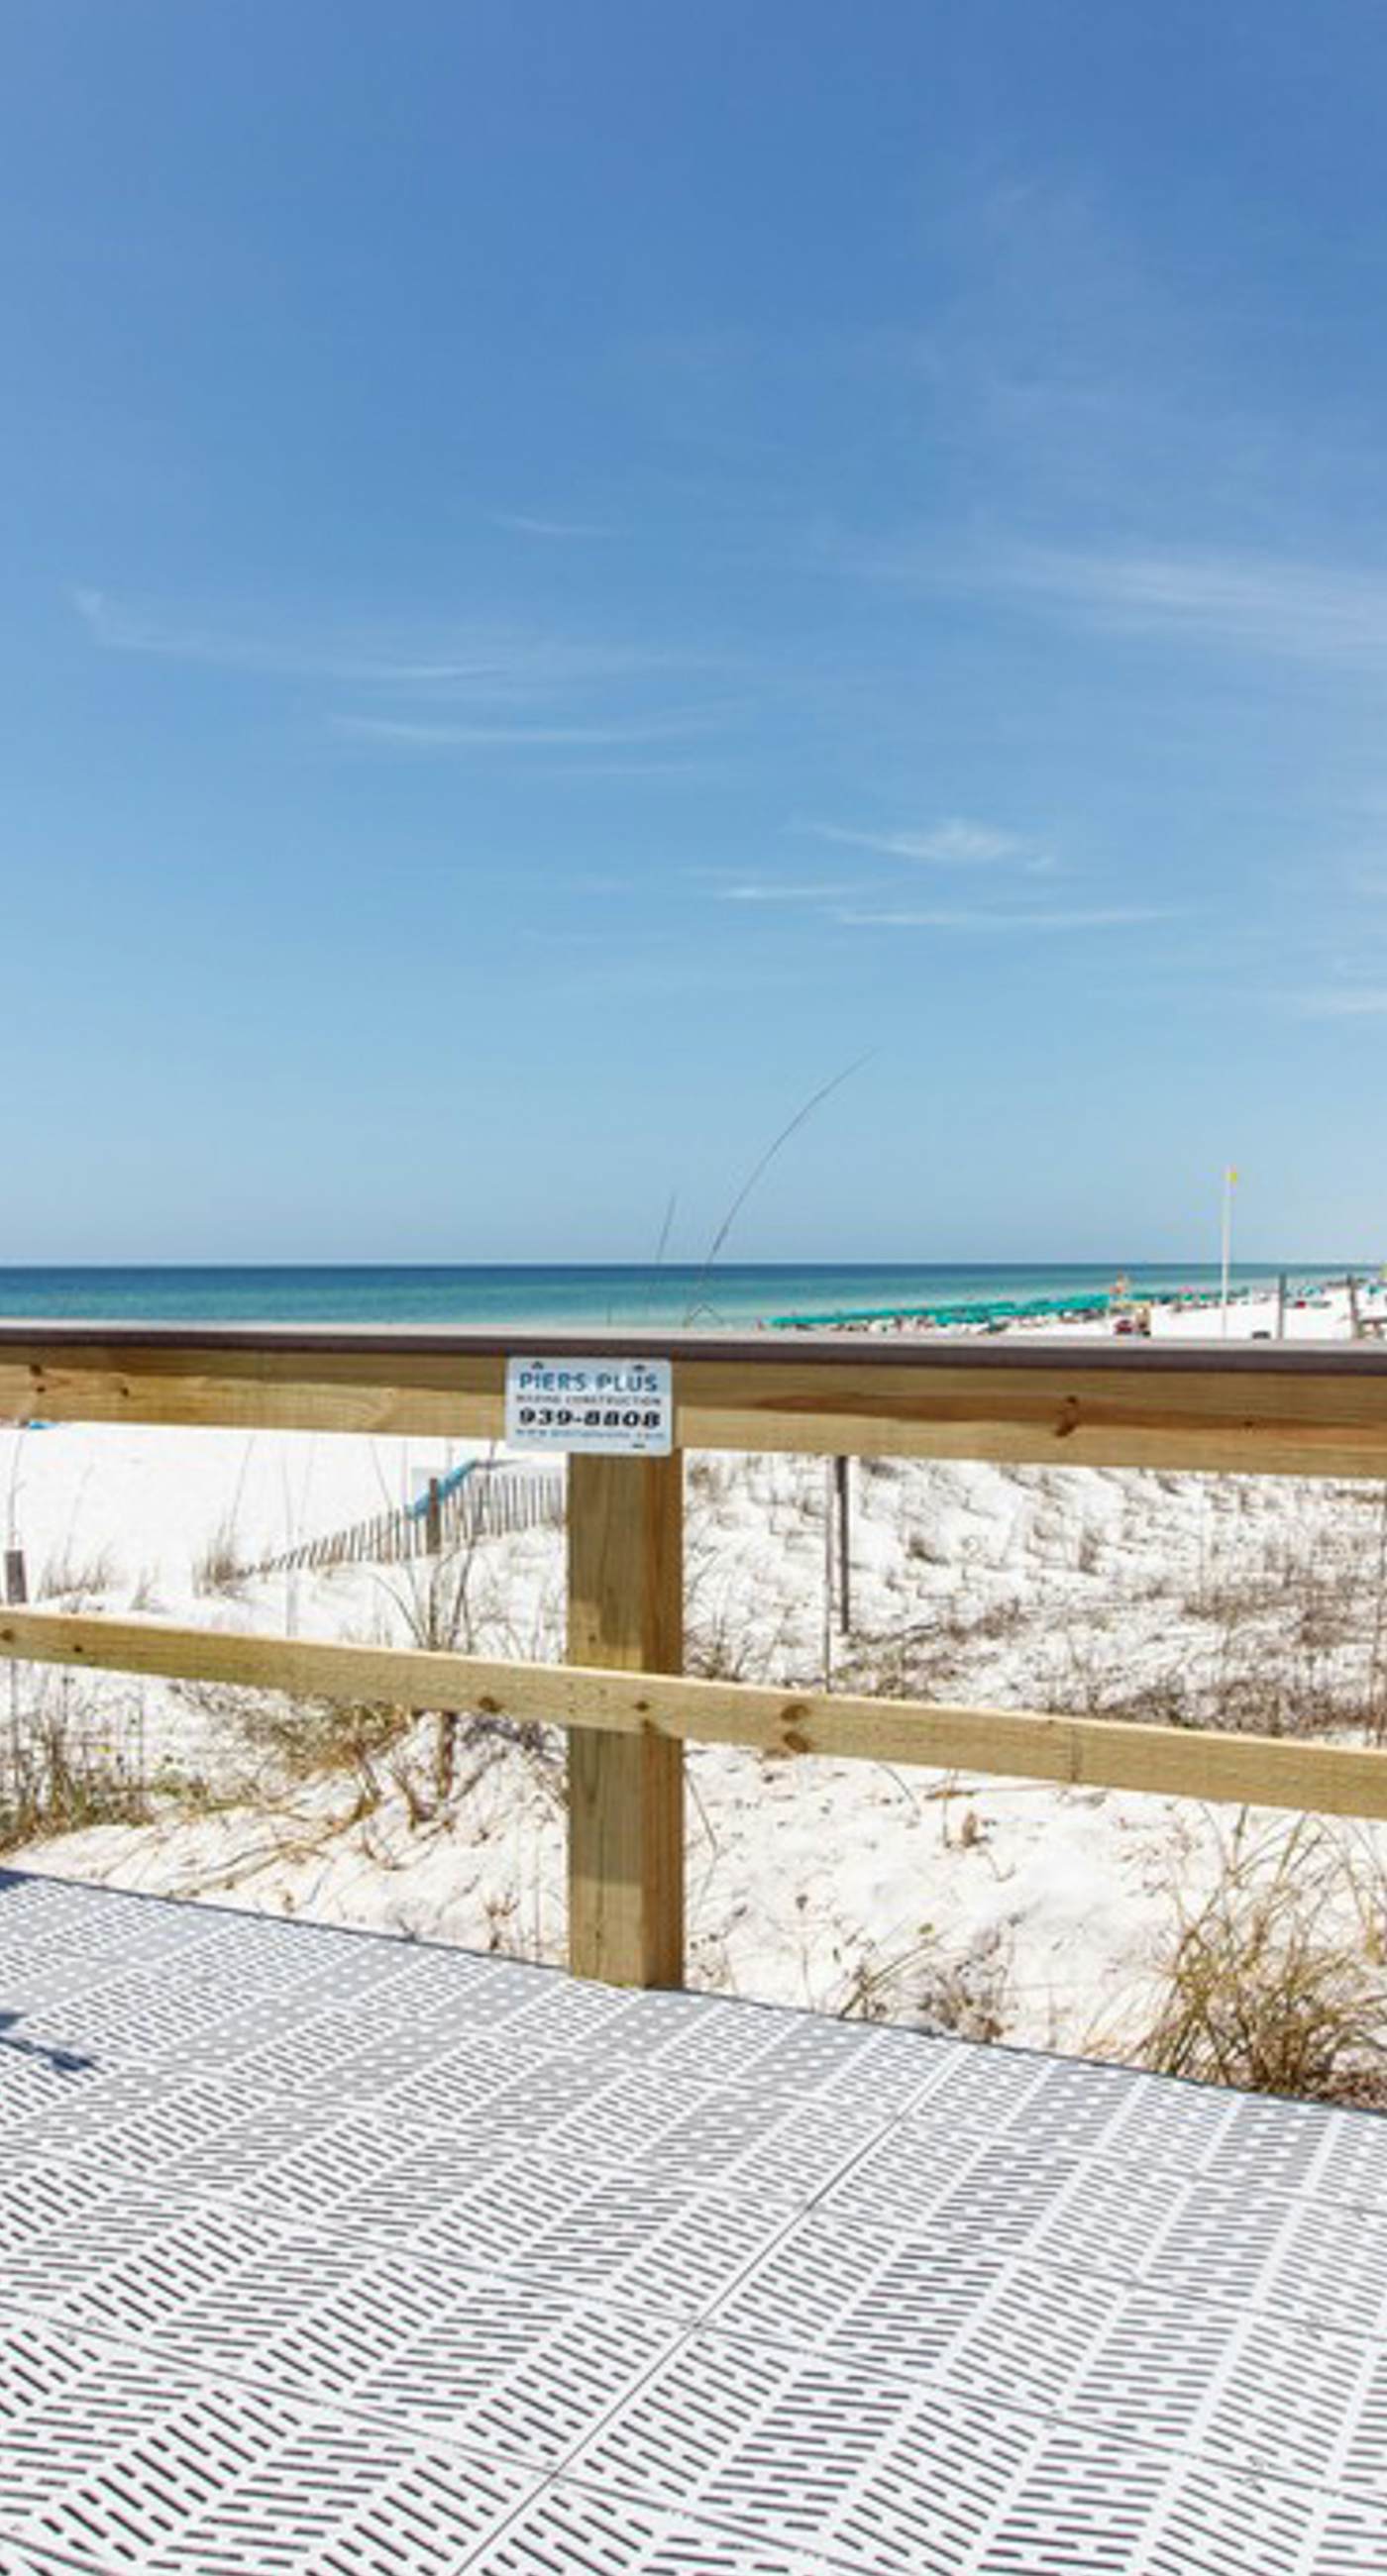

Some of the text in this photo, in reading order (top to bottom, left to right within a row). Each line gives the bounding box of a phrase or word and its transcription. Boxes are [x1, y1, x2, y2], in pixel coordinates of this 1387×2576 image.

[519, 1372, 658, 1392] PIERS PLUS
[566, 1394, 662, 1405] CONSTRUCTION
[519, 1406, 661, 1428] 939-8808
